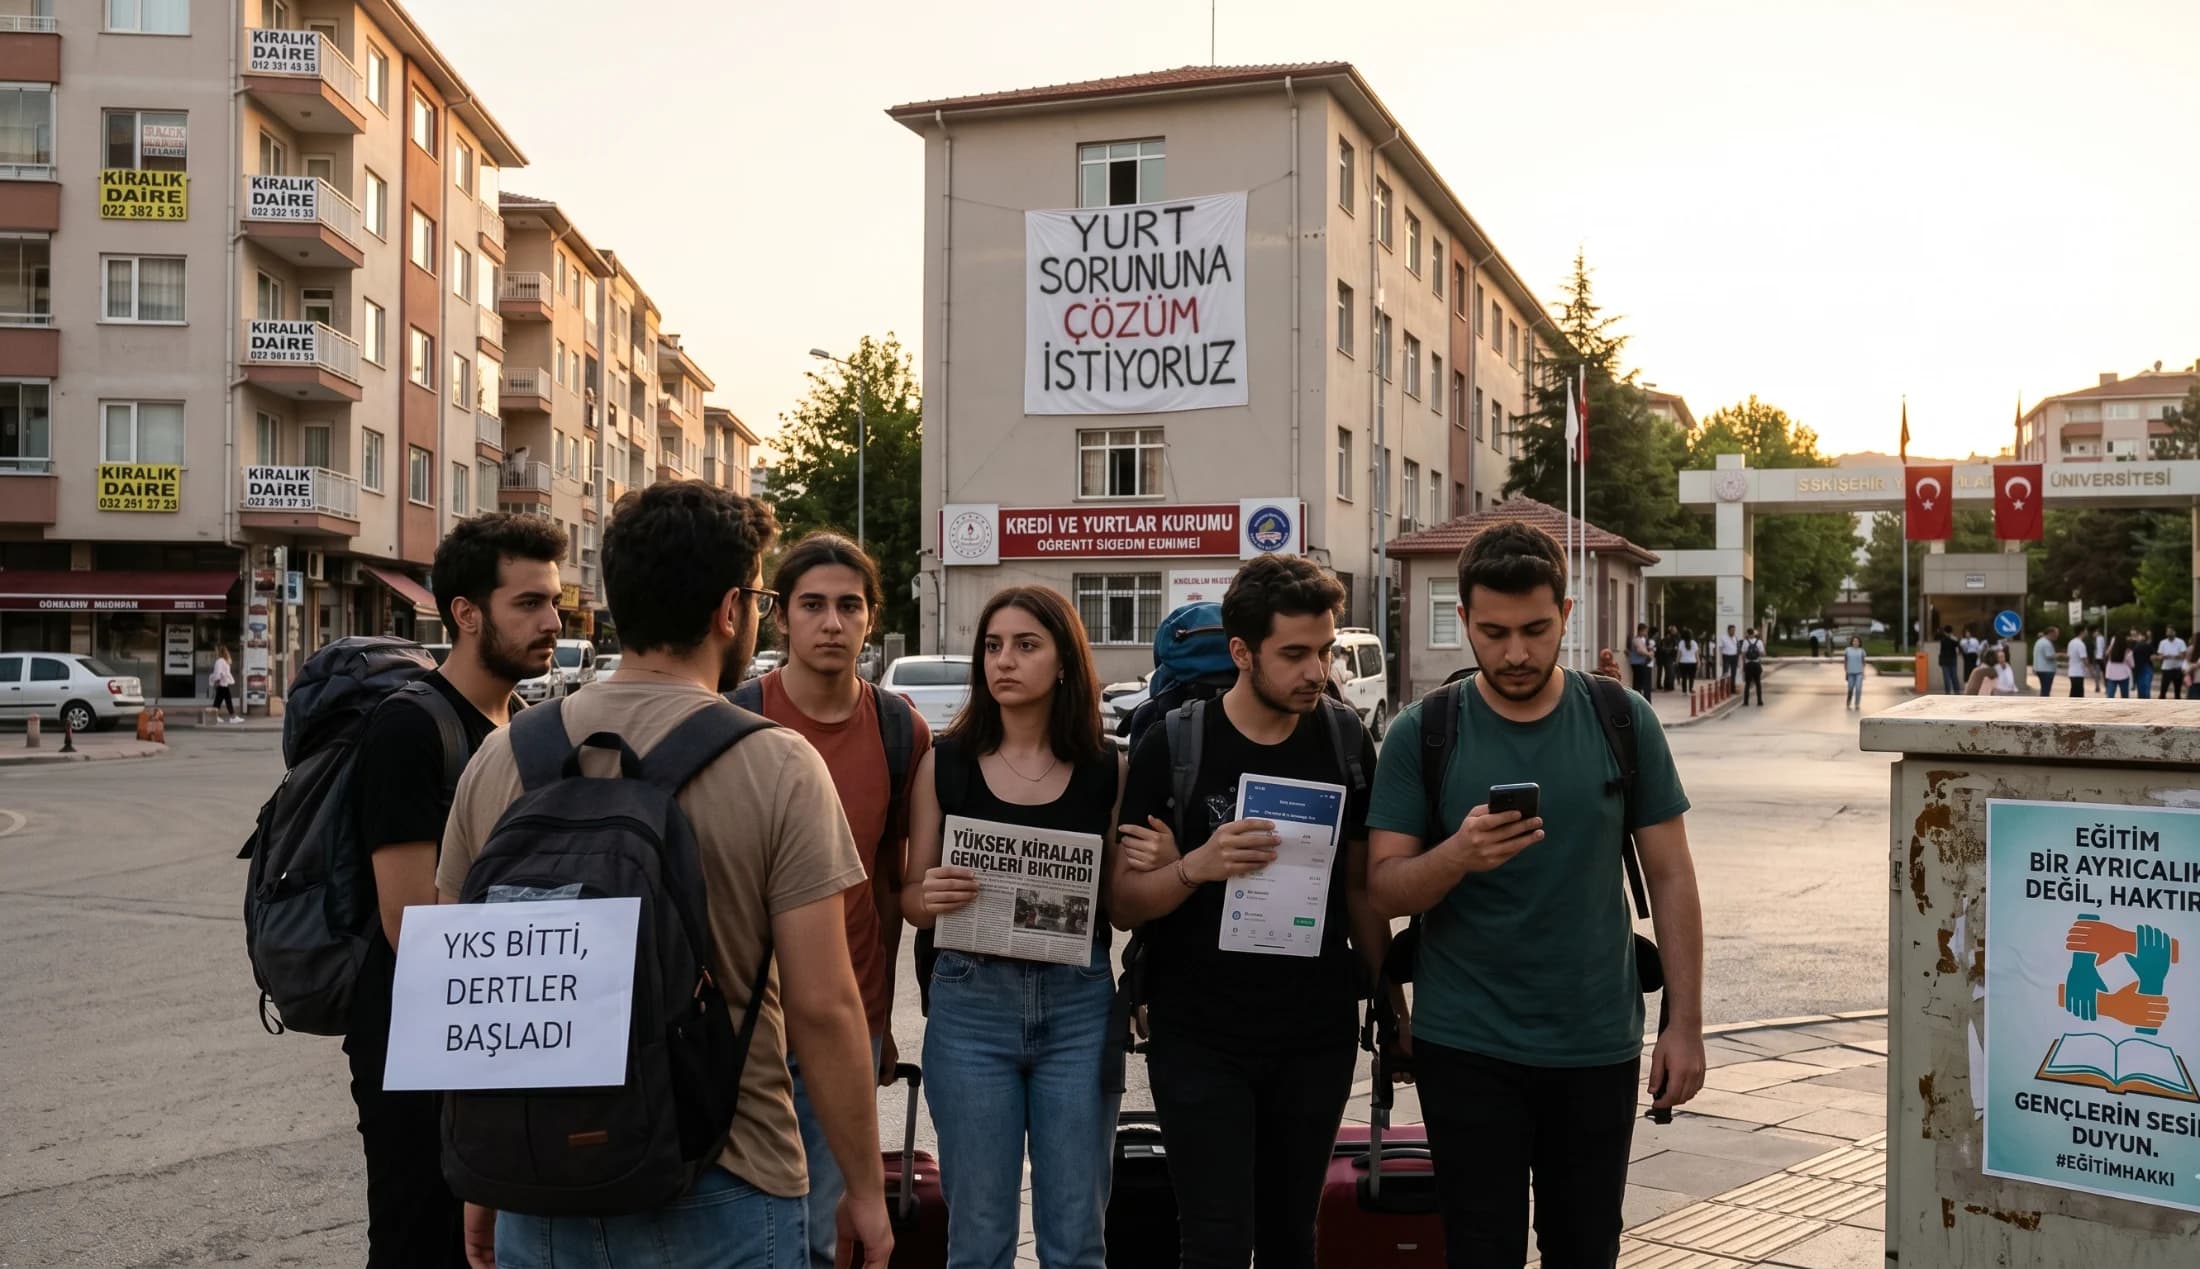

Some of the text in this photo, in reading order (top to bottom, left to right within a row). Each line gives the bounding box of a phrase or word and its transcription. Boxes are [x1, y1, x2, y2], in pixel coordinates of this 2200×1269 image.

[253, 30, 316, 46] KİRALIK
[252, 60, 269, 70] 012
[253, 44, 315, 61] DAİRE
[103, 170, 183, 187] KİRALIK
[252, 176, 314, 191] KİRALIK
[106, 187, 182, 204] DAİRE
[253, 191, 314, 207] DAİRE
[102, 204, 184, 218] 022 382 5 33
[290, 208, 300, 217] 15
[303, 208, 314, 218] 33
[1071, 205, 1195, 252] YURT
[1039, 244, 1232, 295] SORUNUNA
[1063, 293, 1200, 345] ÇÖZÜM
[252, 335, 313, 351] DAİRE
[1043, 339, 1237, 392] İSTİYORUZ
[104, 482, 175, 497] DAİRE
[250, 482, 310, 497] DAİRE
[99, 498, 120, 509] 032
[1006, 513, 1053, 535] KREDİ
[1058, 516, 1078, 534] VE
[1082, 514, 1158, 533] YURTLAR
[1162, 513, 1234, 533] KURUMU
[953, 828, 1094, 866] YÜKSEK KİRALAR
[2076, 823, 2160, 852] EĞİTİM
[950, 850, 1092, 883] GENÇLERİ BIKTIRDI
[2030, 849, 2069, 874] BİR
[2026, 876, 2200, 913] DEĞİL, HAKTIR
[444, 922, 588, 961] YKS BİTTİ,
[446, 974, 577, 1005] DERTLER
[446, 1020, 572, 1058] BAŞLADI
[2015, 1091, 2200, 1138] GENÇLERİN SESİ
[2072, 1126, 2159, 1158] DUYUN.
[2056, 1153, 2175, 1187] #EĞİTİMHAKKI
